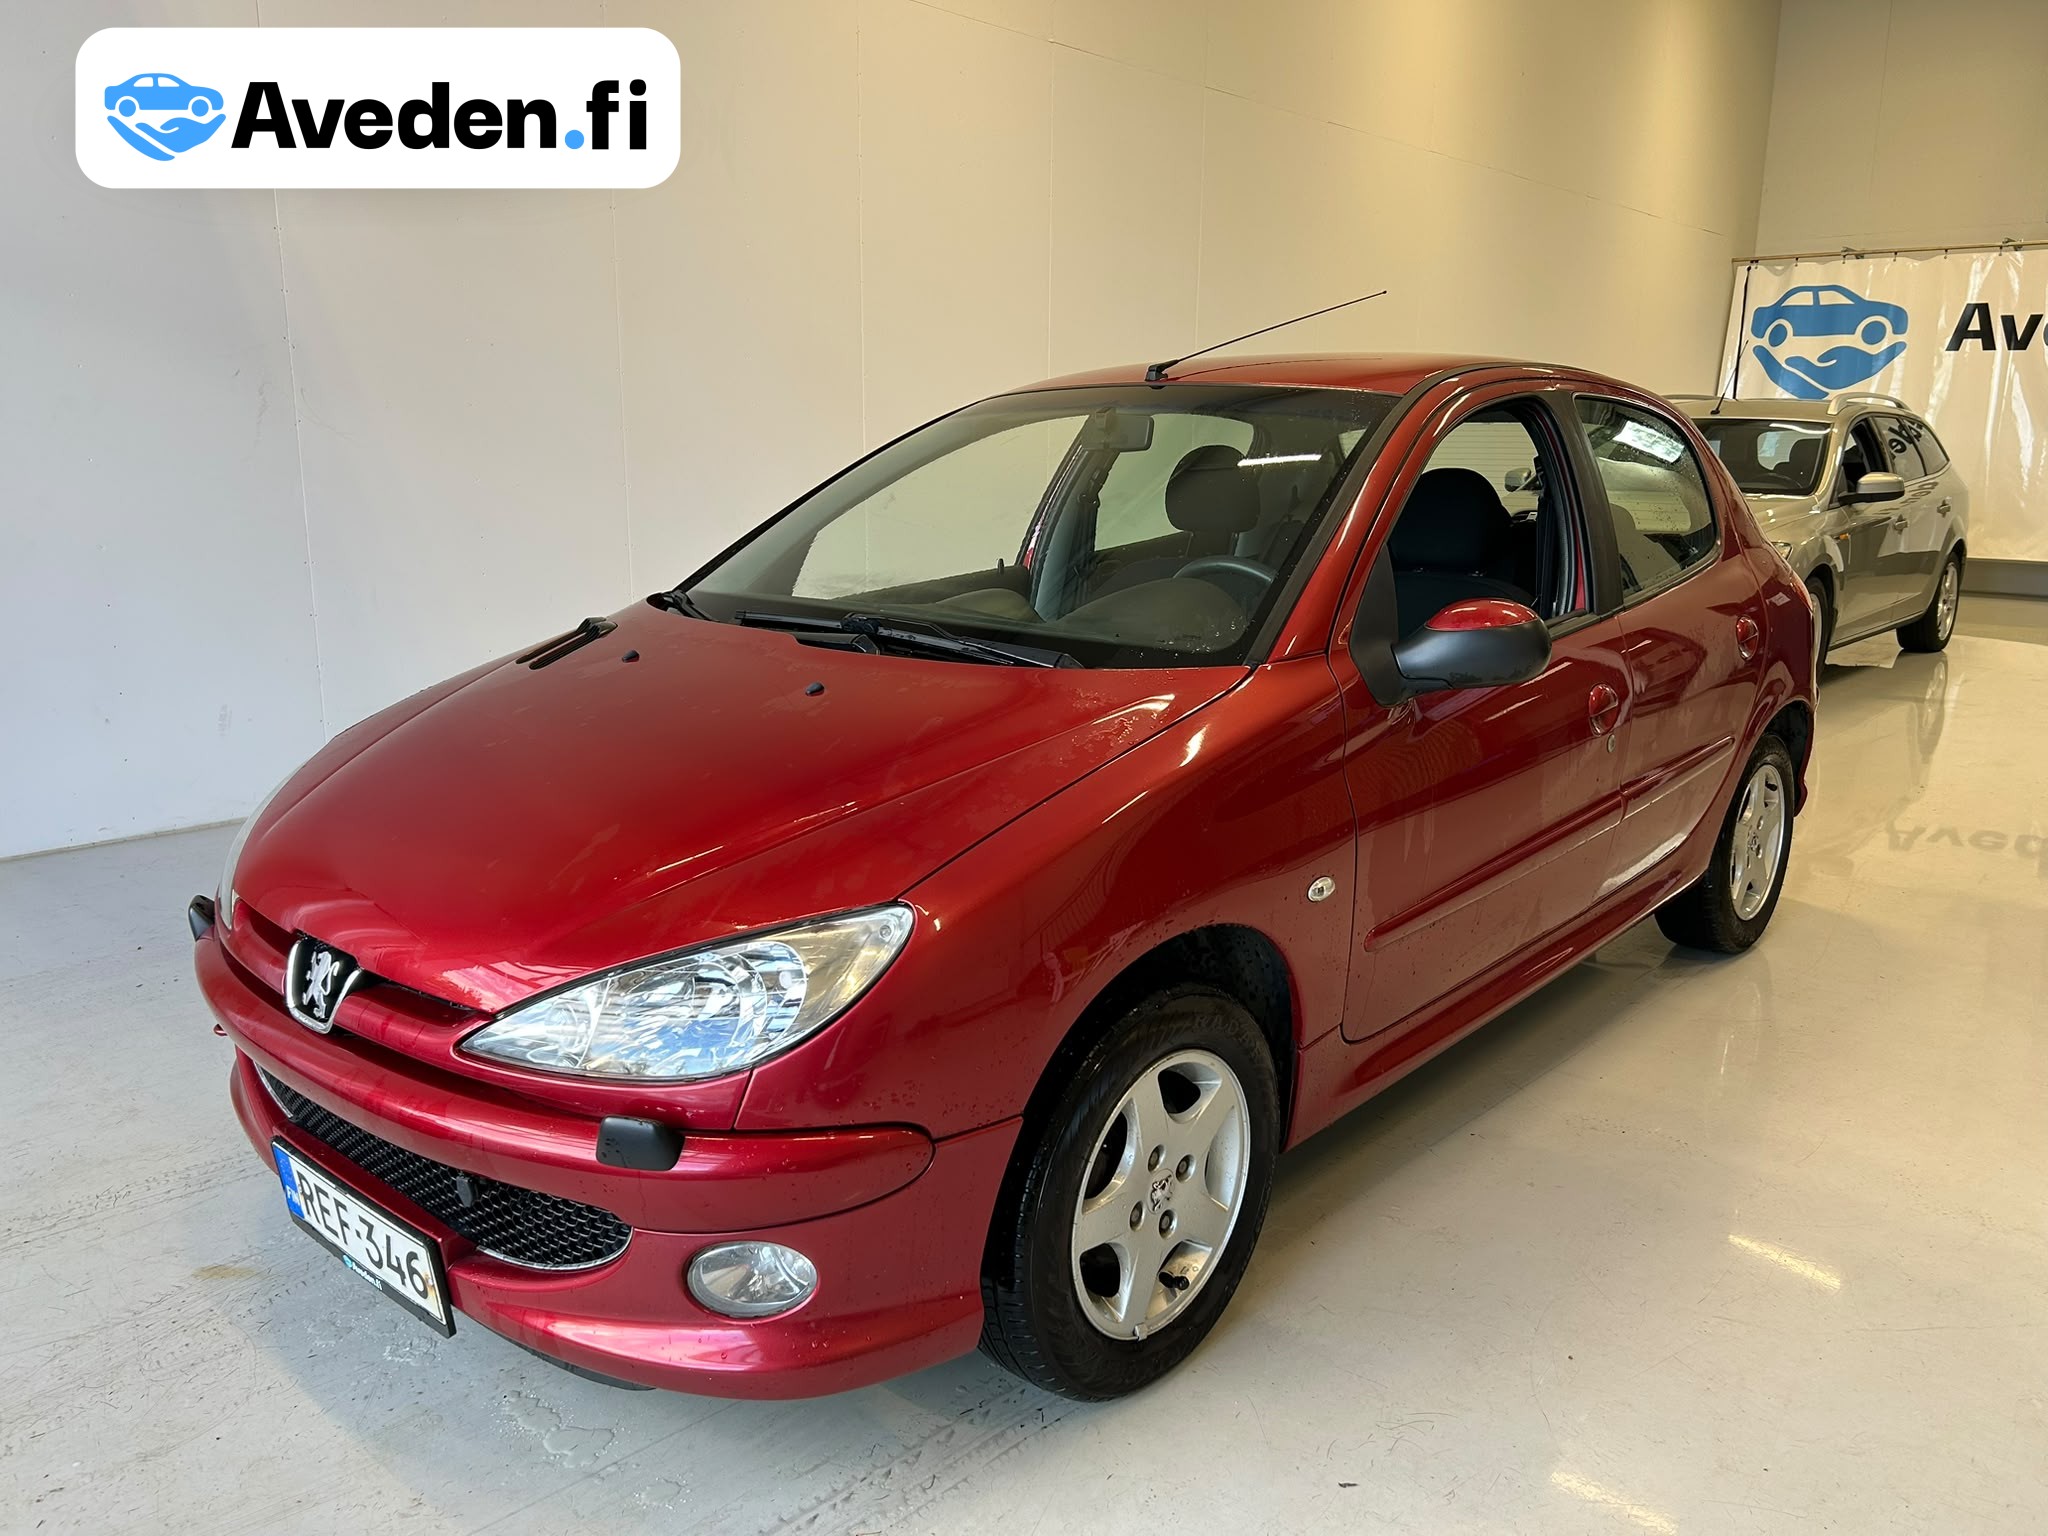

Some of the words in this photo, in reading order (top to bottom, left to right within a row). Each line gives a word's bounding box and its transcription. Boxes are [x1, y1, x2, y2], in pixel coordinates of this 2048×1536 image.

[1945, 302, 2048, 351] Av
[285, 1184, 301, 1207] FIN
[296, 1169, 429, 1300] REF-346
